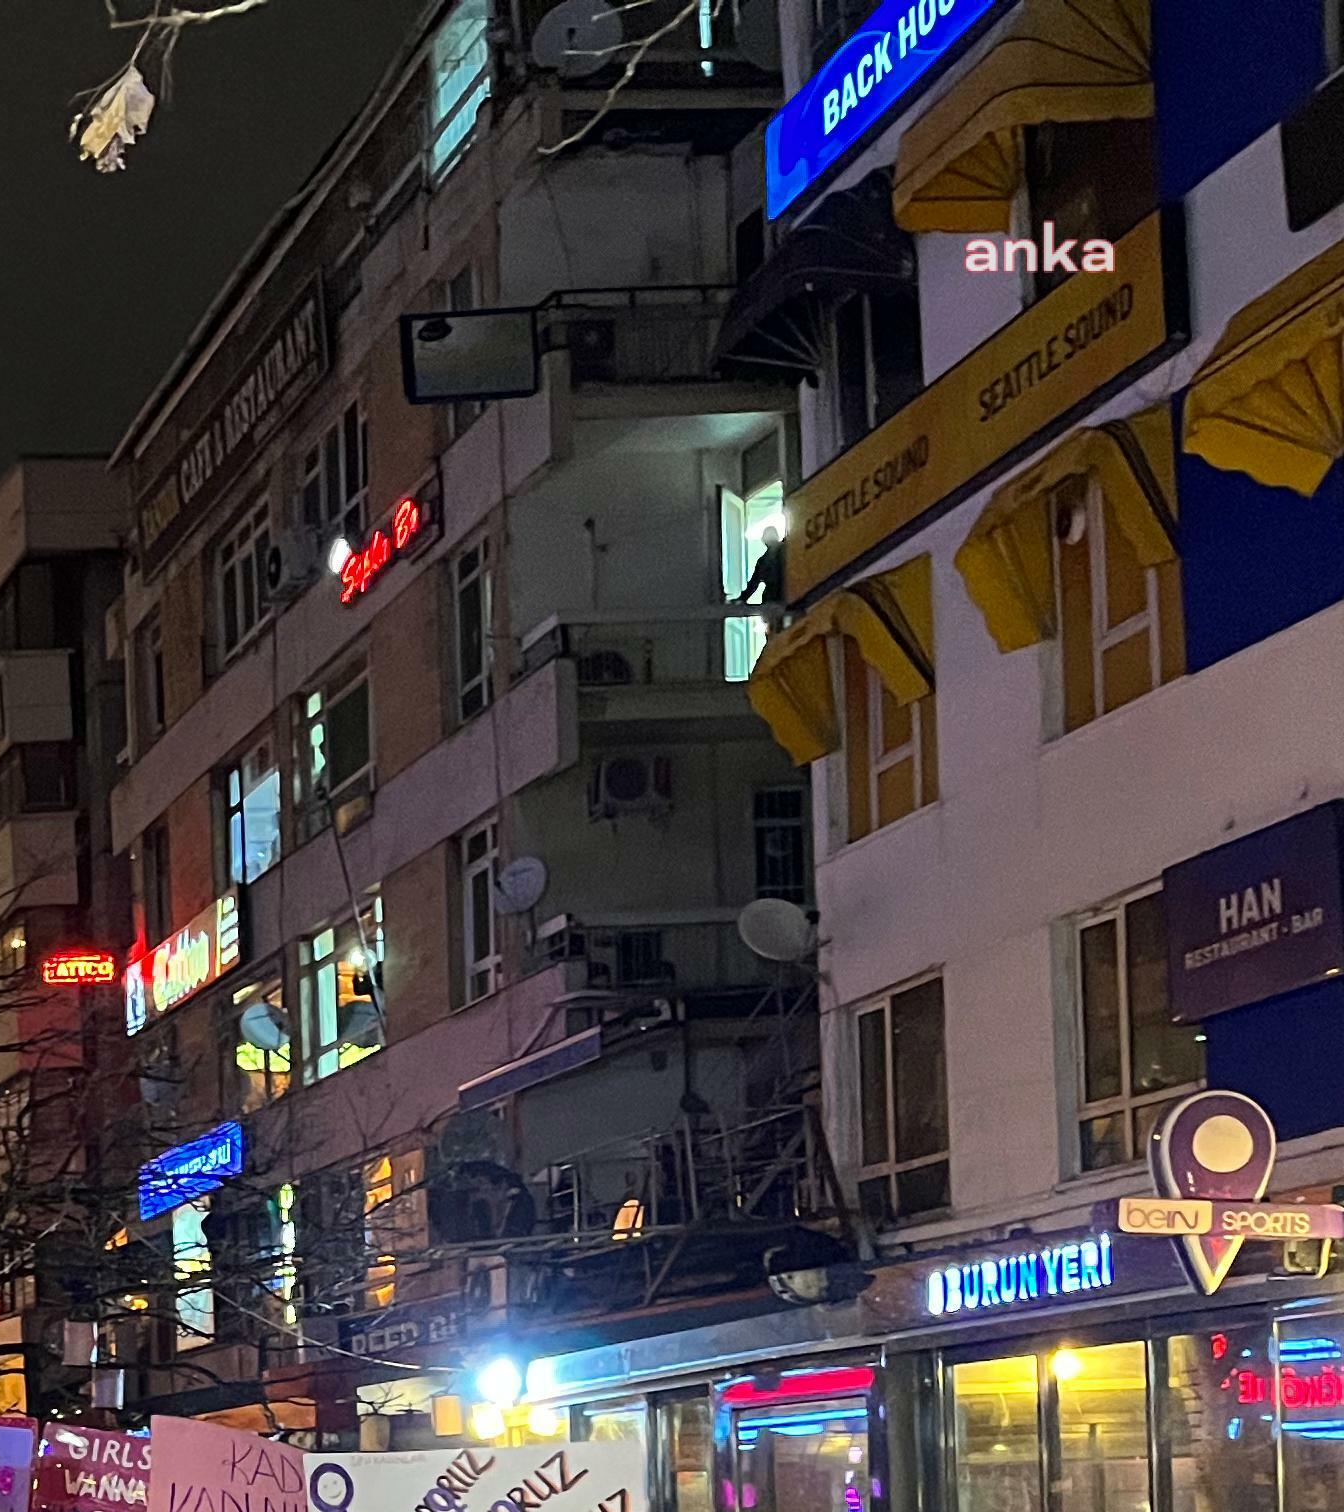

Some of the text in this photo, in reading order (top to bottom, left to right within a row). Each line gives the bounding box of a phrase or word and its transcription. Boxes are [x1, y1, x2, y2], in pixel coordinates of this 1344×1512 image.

[823, 32, 894, 136] BACK
[978, 282, 1133, 423] SEATTLE SOUND
[803, 434, 930, 550] SEATTLE SOUND
[1219, 878, 1283, 933] HAN
[1185, 907, 1324, 970] RESTAURANT BAR
[1222, 1209, 1310, 1233] SPORTS
[68, 1436, 152, 1470] GIRLS
